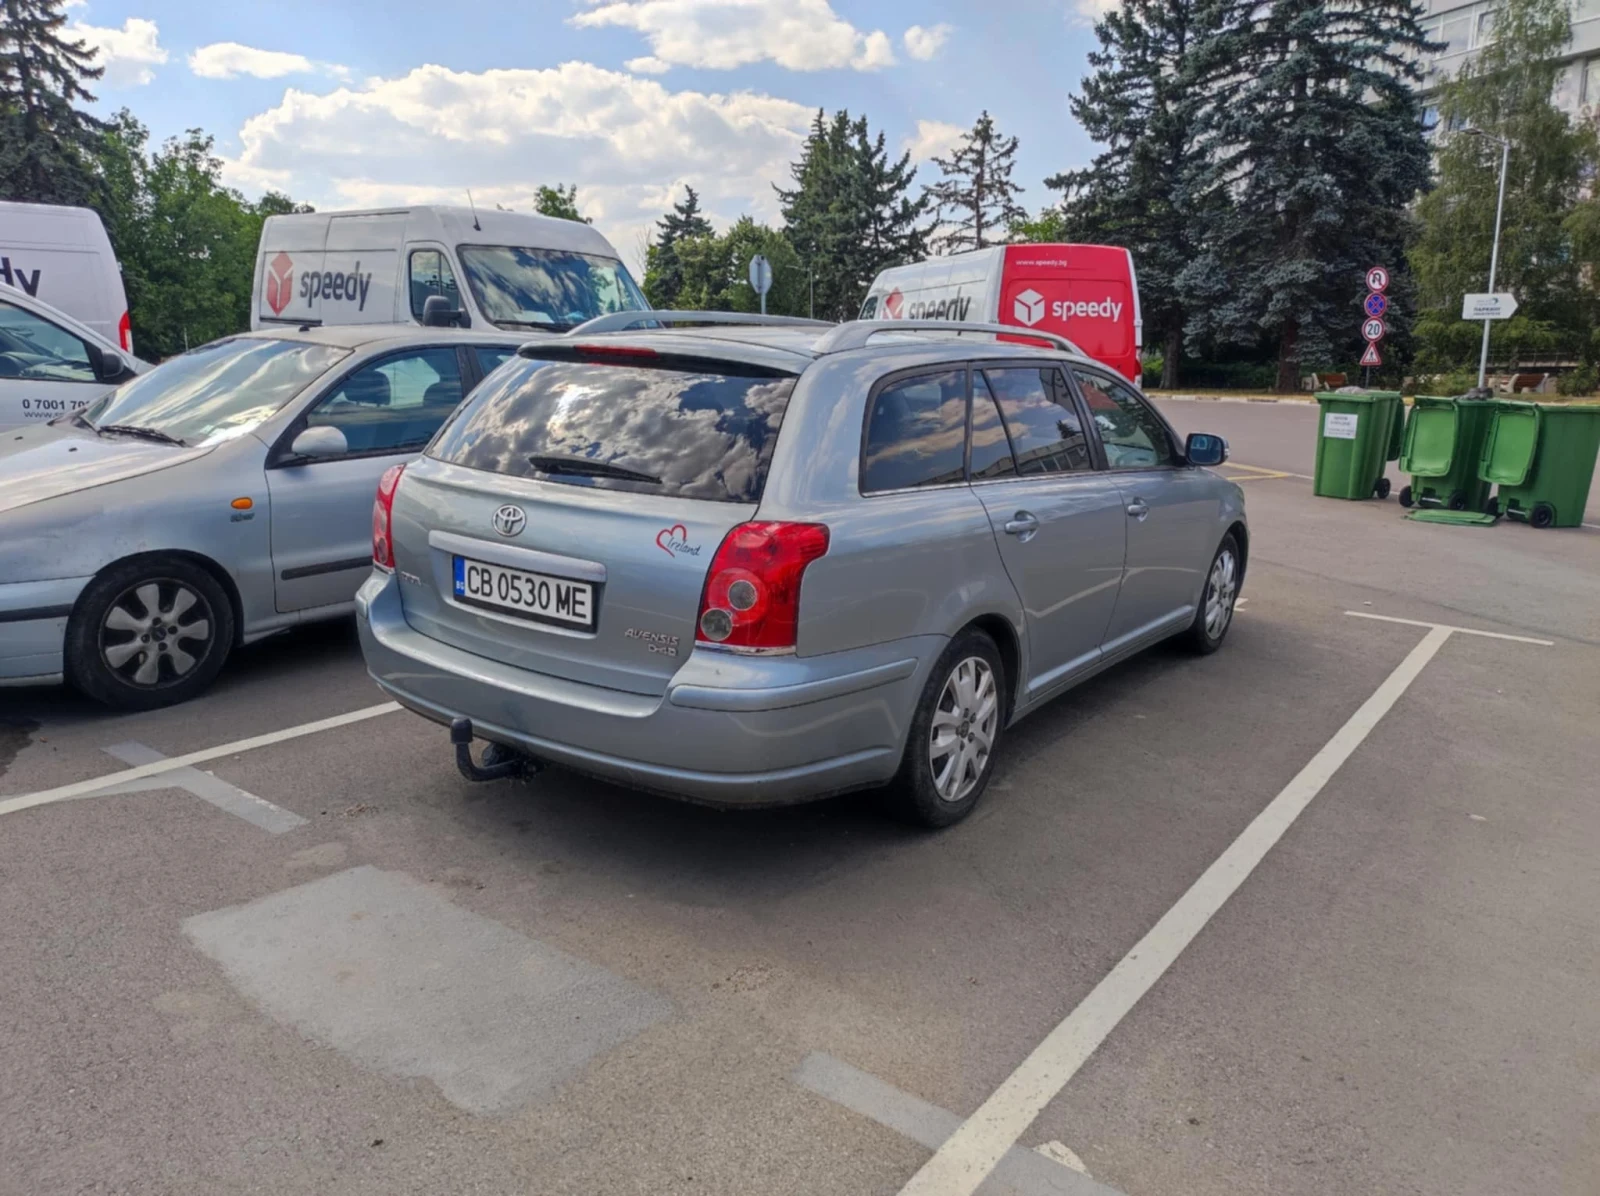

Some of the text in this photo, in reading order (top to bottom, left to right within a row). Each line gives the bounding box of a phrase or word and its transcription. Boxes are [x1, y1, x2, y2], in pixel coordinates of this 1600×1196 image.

[300, 260, 372, 312] speedy
[1052, 296, 1122, 322] speedy
[1367, 323, 1380, 336] 20
[22, 399, 90, 410] 0 7001 70
[667, 537, 701, 557] Ireland
[467, 565, 587, 619] CB 0530 ME
[624, 628, 679, 646] AVENSIS
